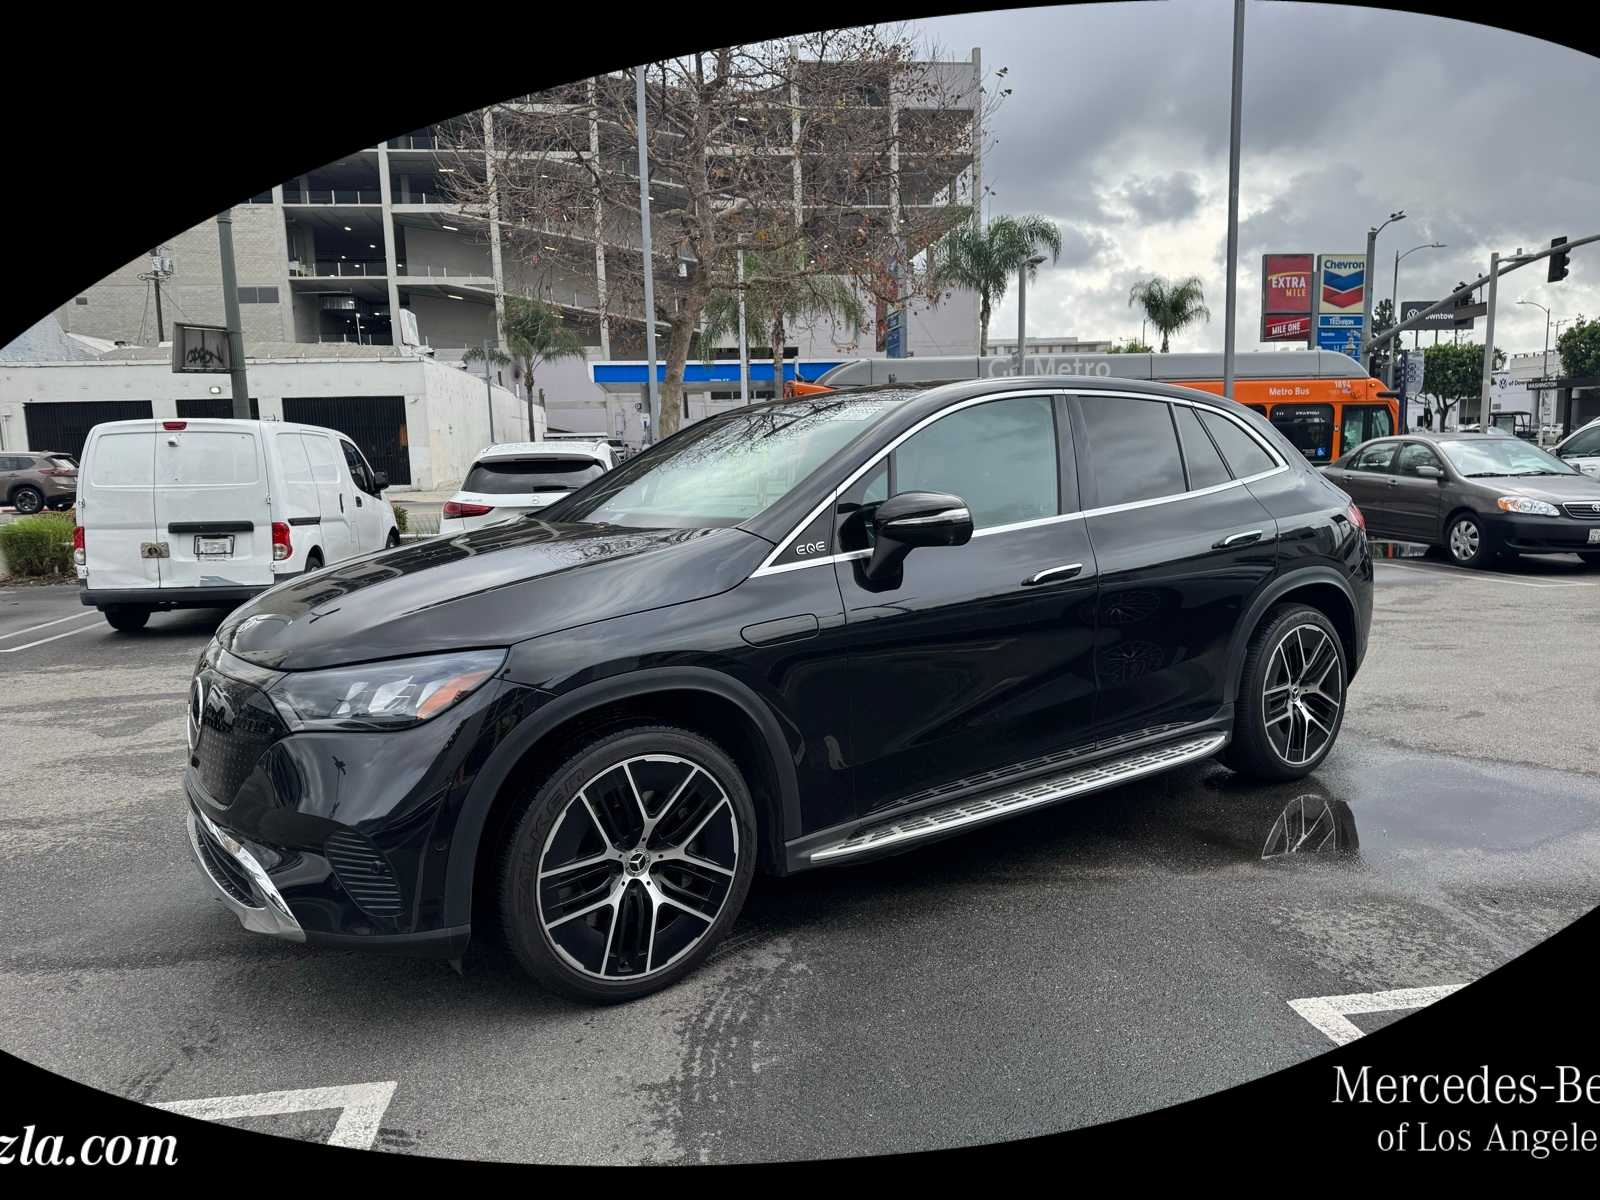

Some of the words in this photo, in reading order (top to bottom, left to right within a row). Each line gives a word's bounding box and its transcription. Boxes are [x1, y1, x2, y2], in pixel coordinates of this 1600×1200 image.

[1324, 260, 1365, 269] Chevron
[1272, 276, 1306, 288] EXTRA
[1286, 288, 1306, 296] MILE
[1272, 324, 1286, 335] MILE
[1287, 322, 1301, 332] ONE
[1033, 358, 1112, 376] Metro
[1269, 387, 1294, 397] Metro
[1295, 387, 1310, 397] Bus
[796, 541, 826, 555] EQE
